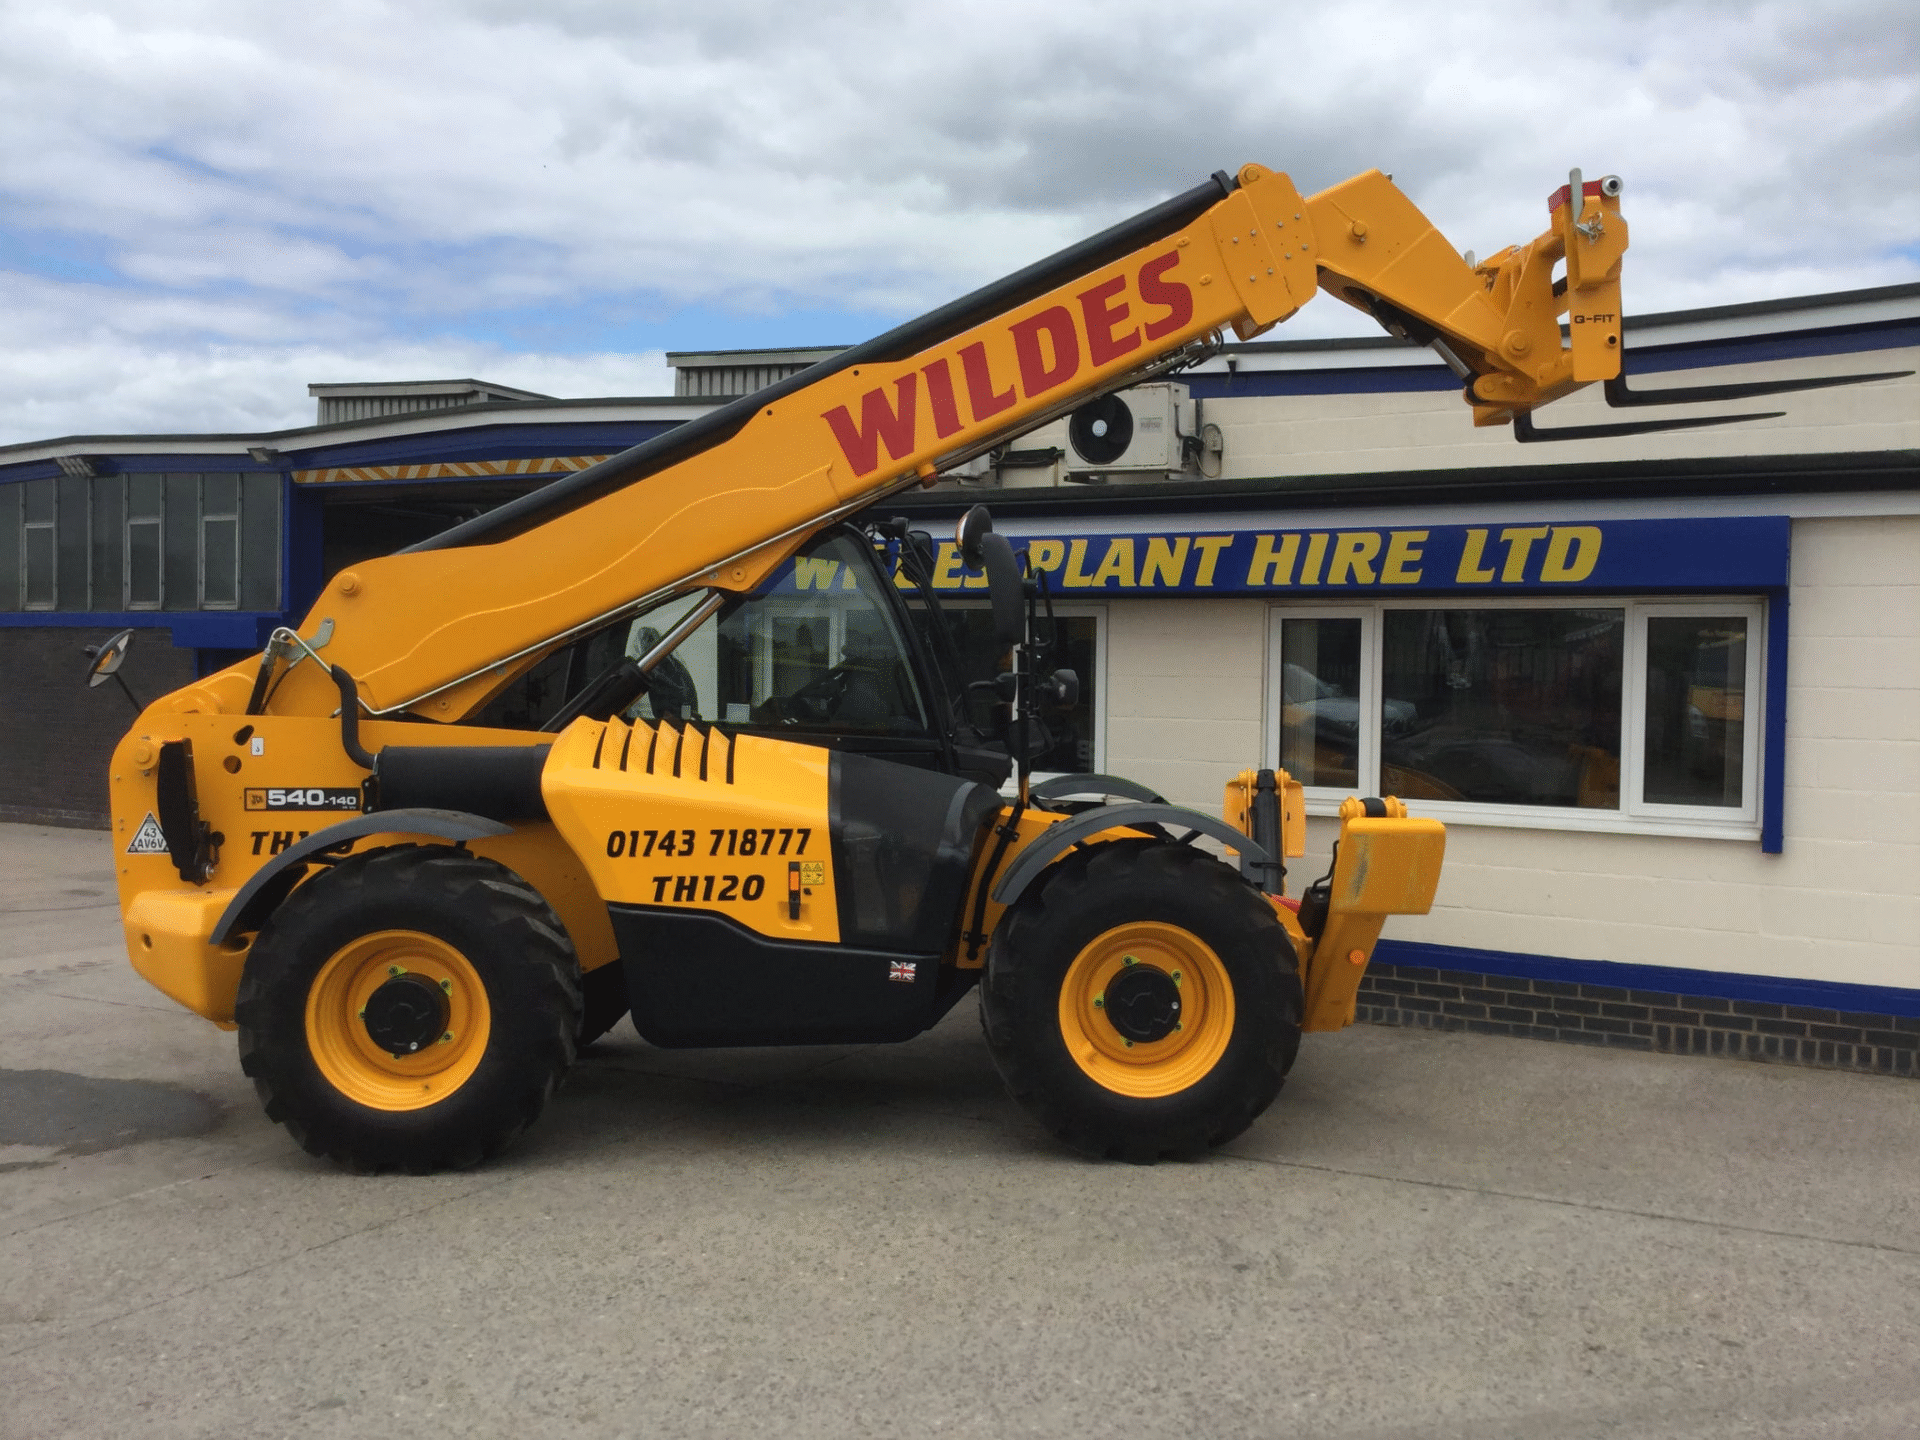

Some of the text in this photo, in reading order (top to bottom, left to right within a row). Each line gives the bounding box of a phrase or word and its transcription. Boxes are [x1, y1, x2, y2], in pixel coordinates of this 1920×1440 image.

[820, 249, 1193, 477] WILDES
[1026, 535, 1234, 587] PLANT
[1246, 530, 1429, 586] HIRE
[1455, 525, 1603, 583] LTD
[137, 838, 164, 849] AV6V
[143, 827, 157, 838] 43
[606, 828, 812, 858] 01743 718777
[652, 874, 765, 902] TH120
